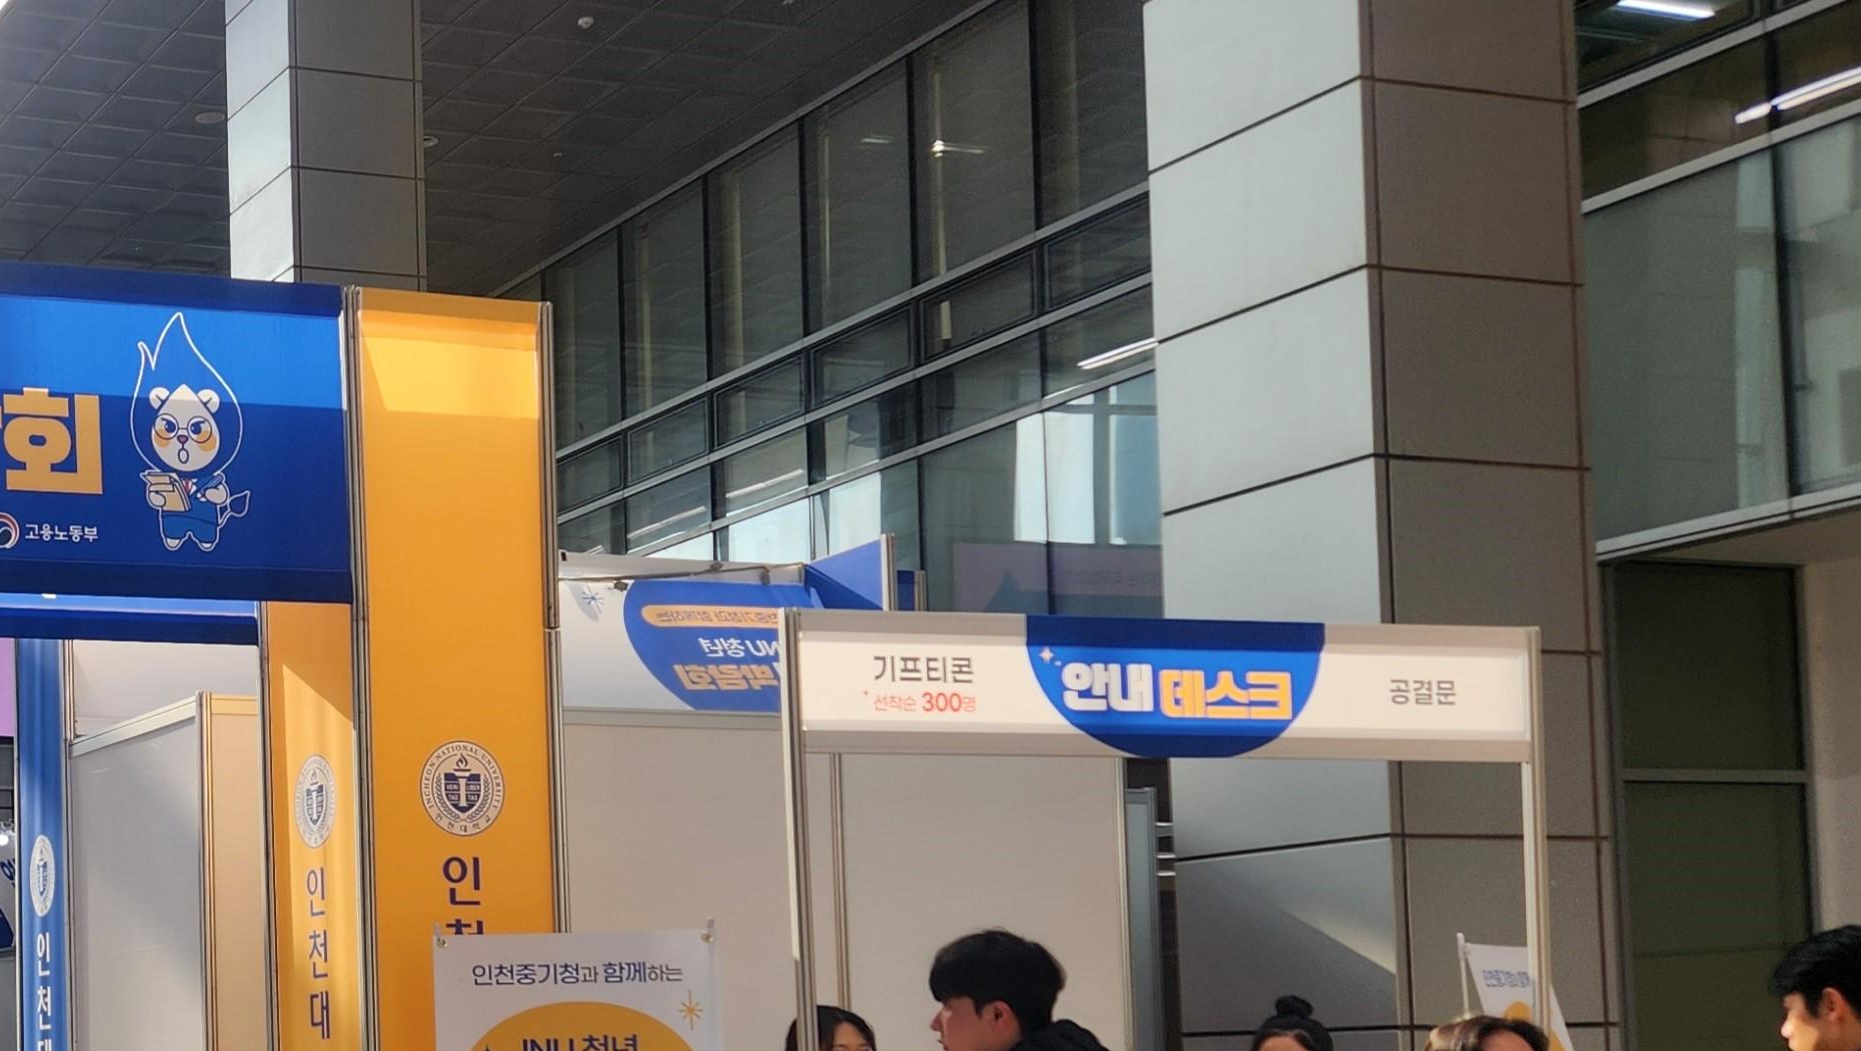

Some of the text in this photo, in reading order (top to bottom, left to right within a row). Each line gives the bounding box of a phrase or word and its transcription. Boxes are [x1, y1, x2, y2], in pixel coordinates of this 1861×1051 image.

[24, 522, 99, 543] 고용노동부
[874, 655, 974, 685] 기프티콘
[921, 690, 977, 715] 300명
[1062, 660, 1293, 720] 안내 데스크
[1389, 678, 1457, 707] 공결문
[472, 961, 683, 986] 인천중기청과 함께하는
